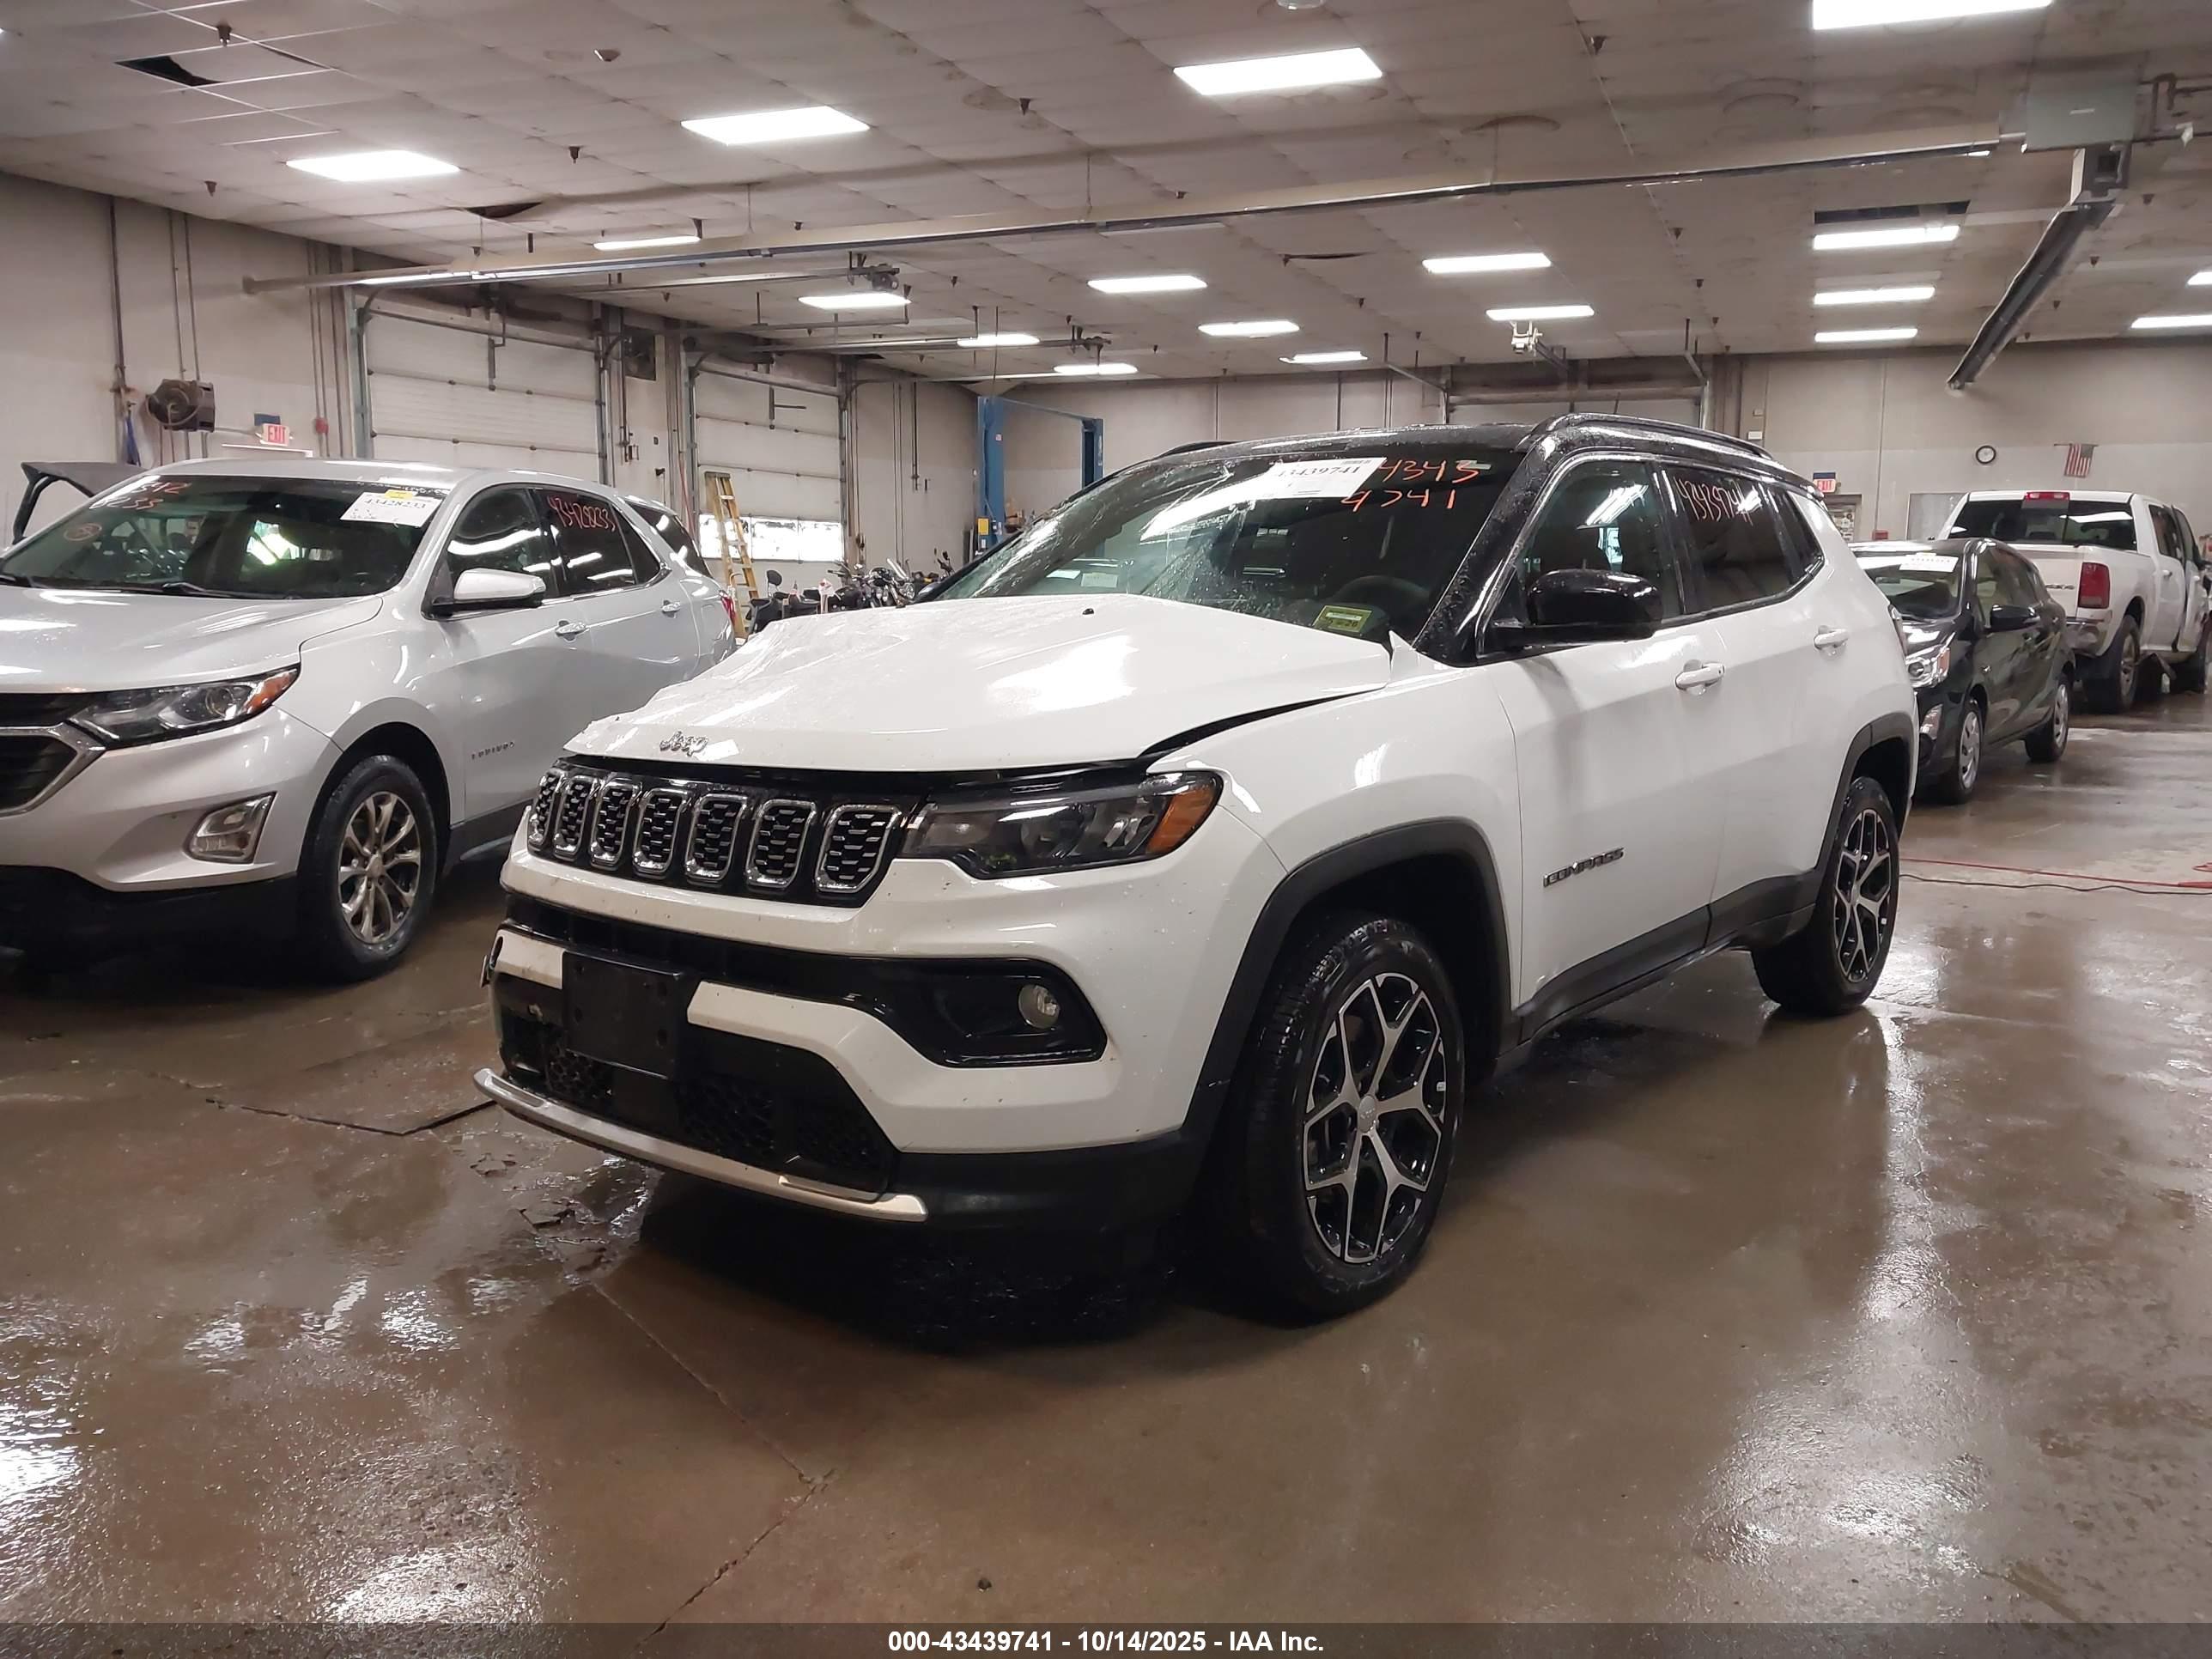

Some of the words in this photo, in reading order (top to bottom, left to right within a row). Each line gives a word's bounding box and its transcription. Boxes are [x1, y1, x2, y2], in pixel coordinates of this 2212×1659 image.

[267, 425, 287, 444] EXIT
[659, 730, 708, 757] Jeep
[1543, 847, 1625, 888] COMPASS
